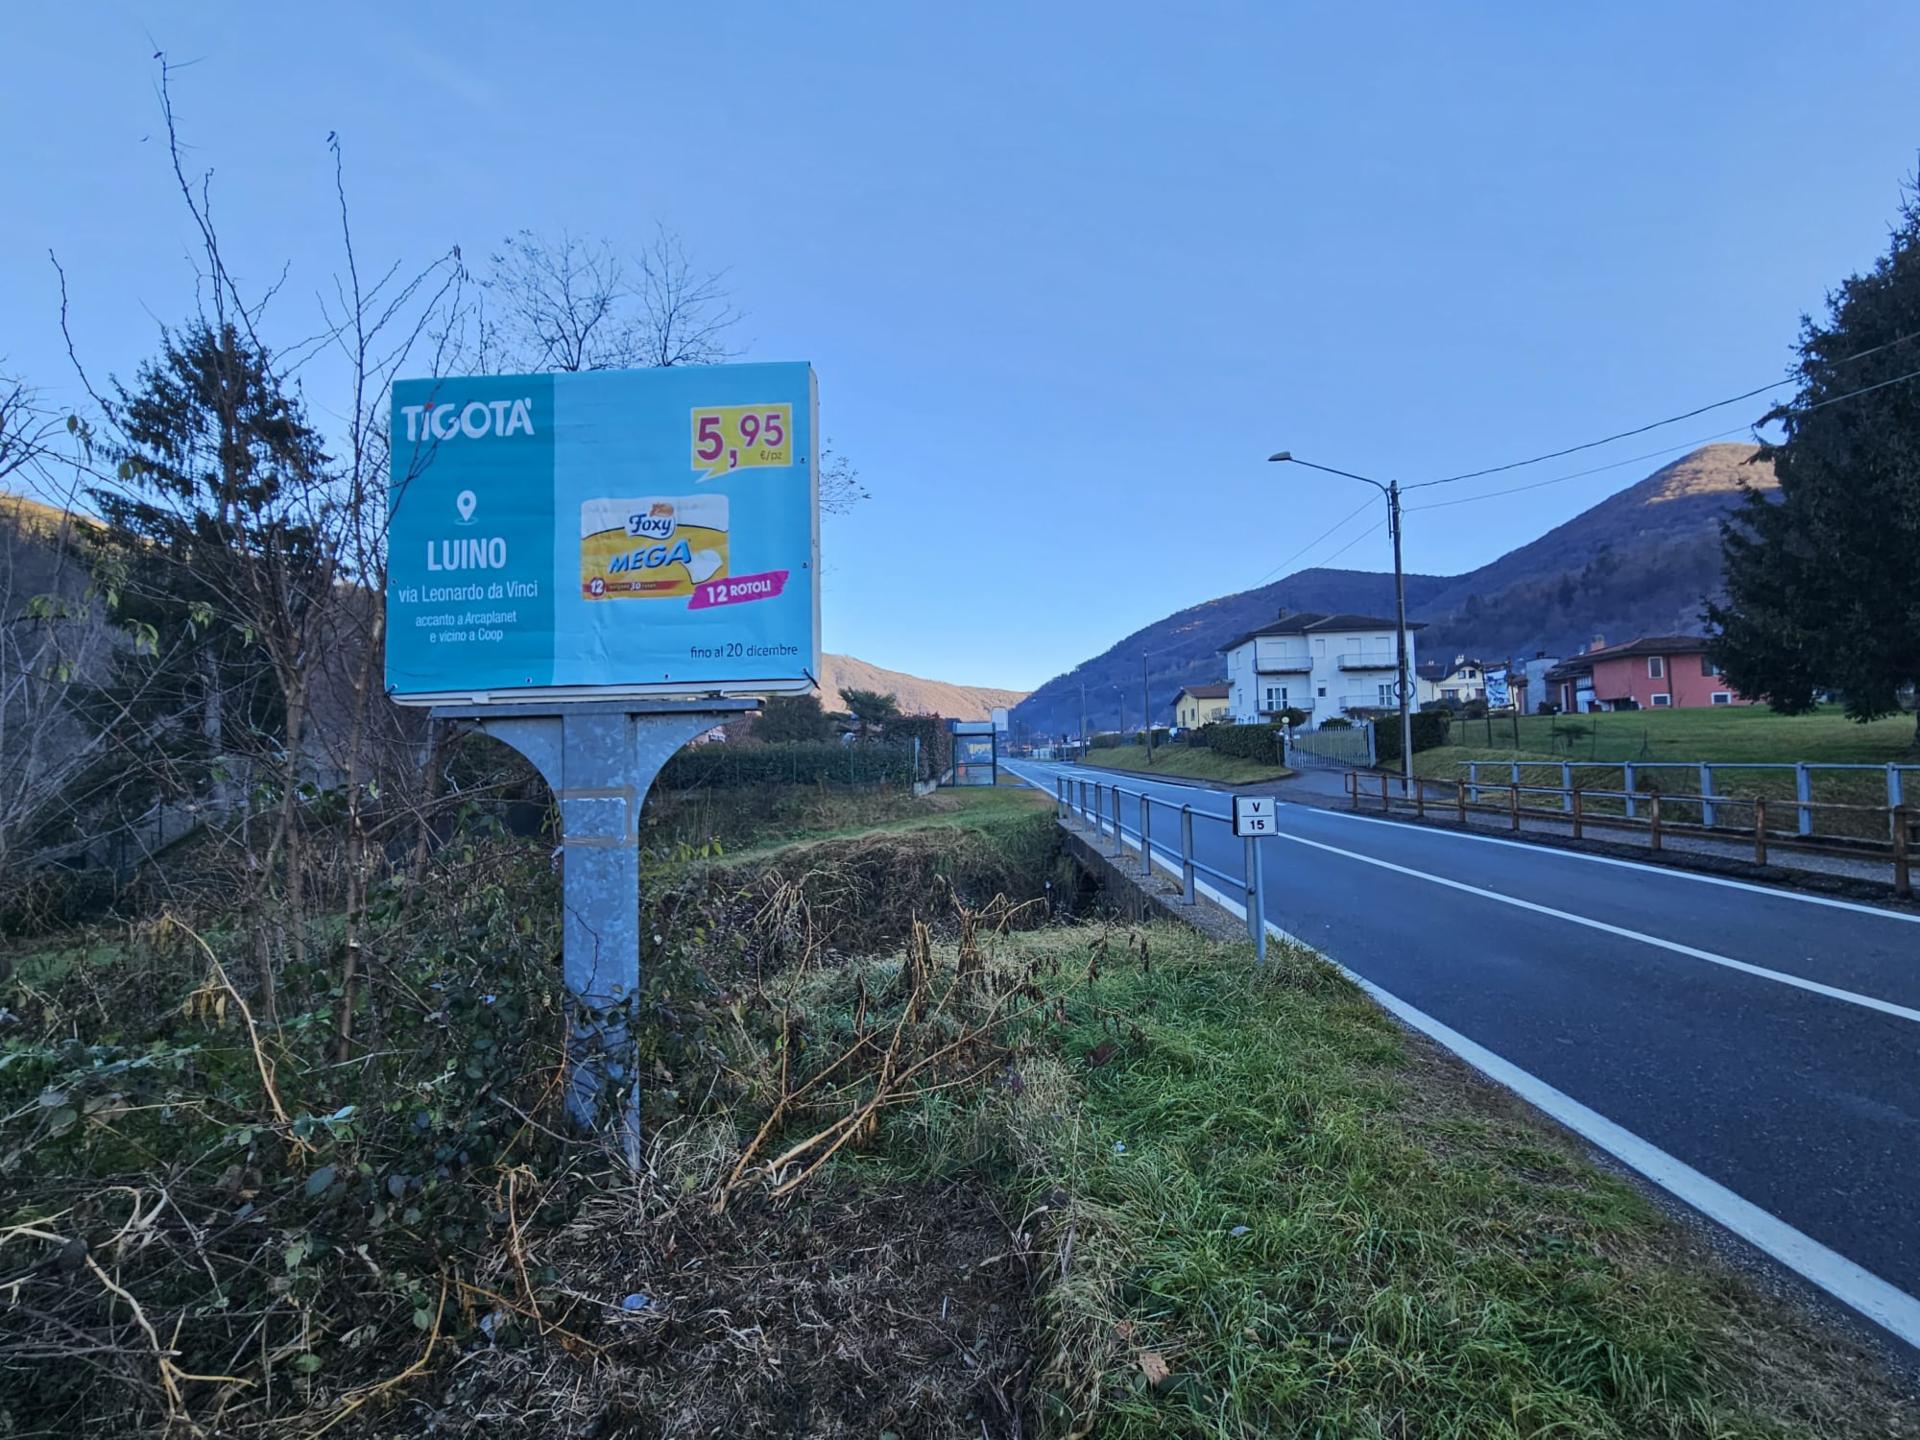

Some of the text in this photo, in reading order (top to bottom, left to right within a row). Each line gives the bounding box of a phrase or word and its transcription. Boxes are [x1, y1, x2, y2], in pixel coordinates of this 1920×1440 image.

[696, 413, 784, 469] 5,95
[629, 513, 672, 537] Foxy
[427, 536, 507, 571] LUINO
[608, 538, 692, 574] MEGA
[397, 579, 539, 603] via Leonardo da Vinci
[590, 579, 604, 594] 12
[707, 580, 771, 604] 12 ROTOLI
[415, 609, 518, 627] accanto a Arcaplanet
[430, 627, 504, 643] e vicino a Coop
[690, 642, 799, 659] fino al 20 dicembre
[1252, 802, 1261, 813] V
[1249, 819, 1265, 831] 15
